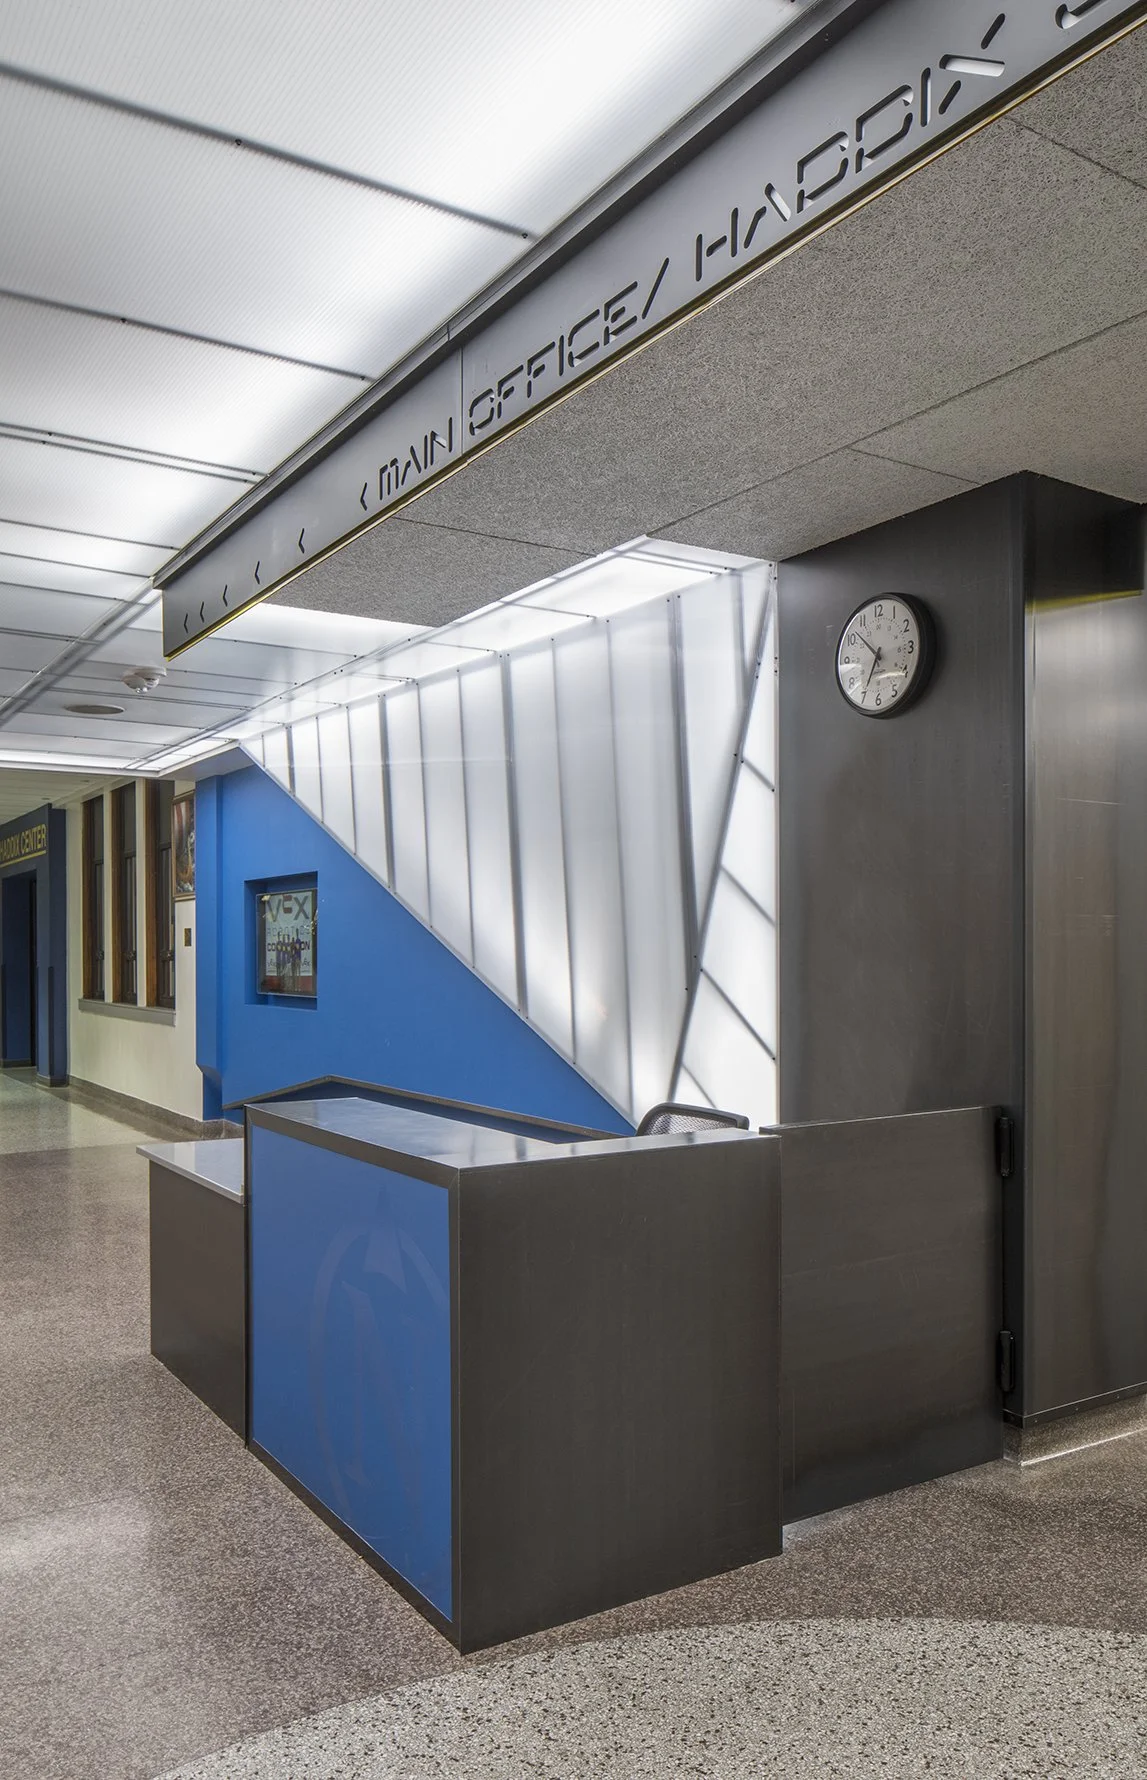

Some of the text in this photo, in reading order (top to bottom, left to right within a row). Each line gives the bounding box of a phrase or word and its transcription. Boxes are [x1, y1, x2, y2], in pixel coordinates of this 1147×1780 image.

[379, 416, 453, 500] MAIN
[695, 13, 1005, 282] HADDIX
[874, 604, 884, 618] 12
[892, 605, 896, 620] 1
[860, 614, 866, 628] 11
[903, 619, 910, 633] 2
[847, 633, 856, 647] 10
[907, 640, 915, 654] 3
[848, 677, 855, 689] 8
[861, 691, 868, 705] 7
[891, 684, 898, 698] 5
[875, 693, 882, 706] 6
[20, 823, 47, 855] CENTER
[266, 894, 310, 922] VEX
